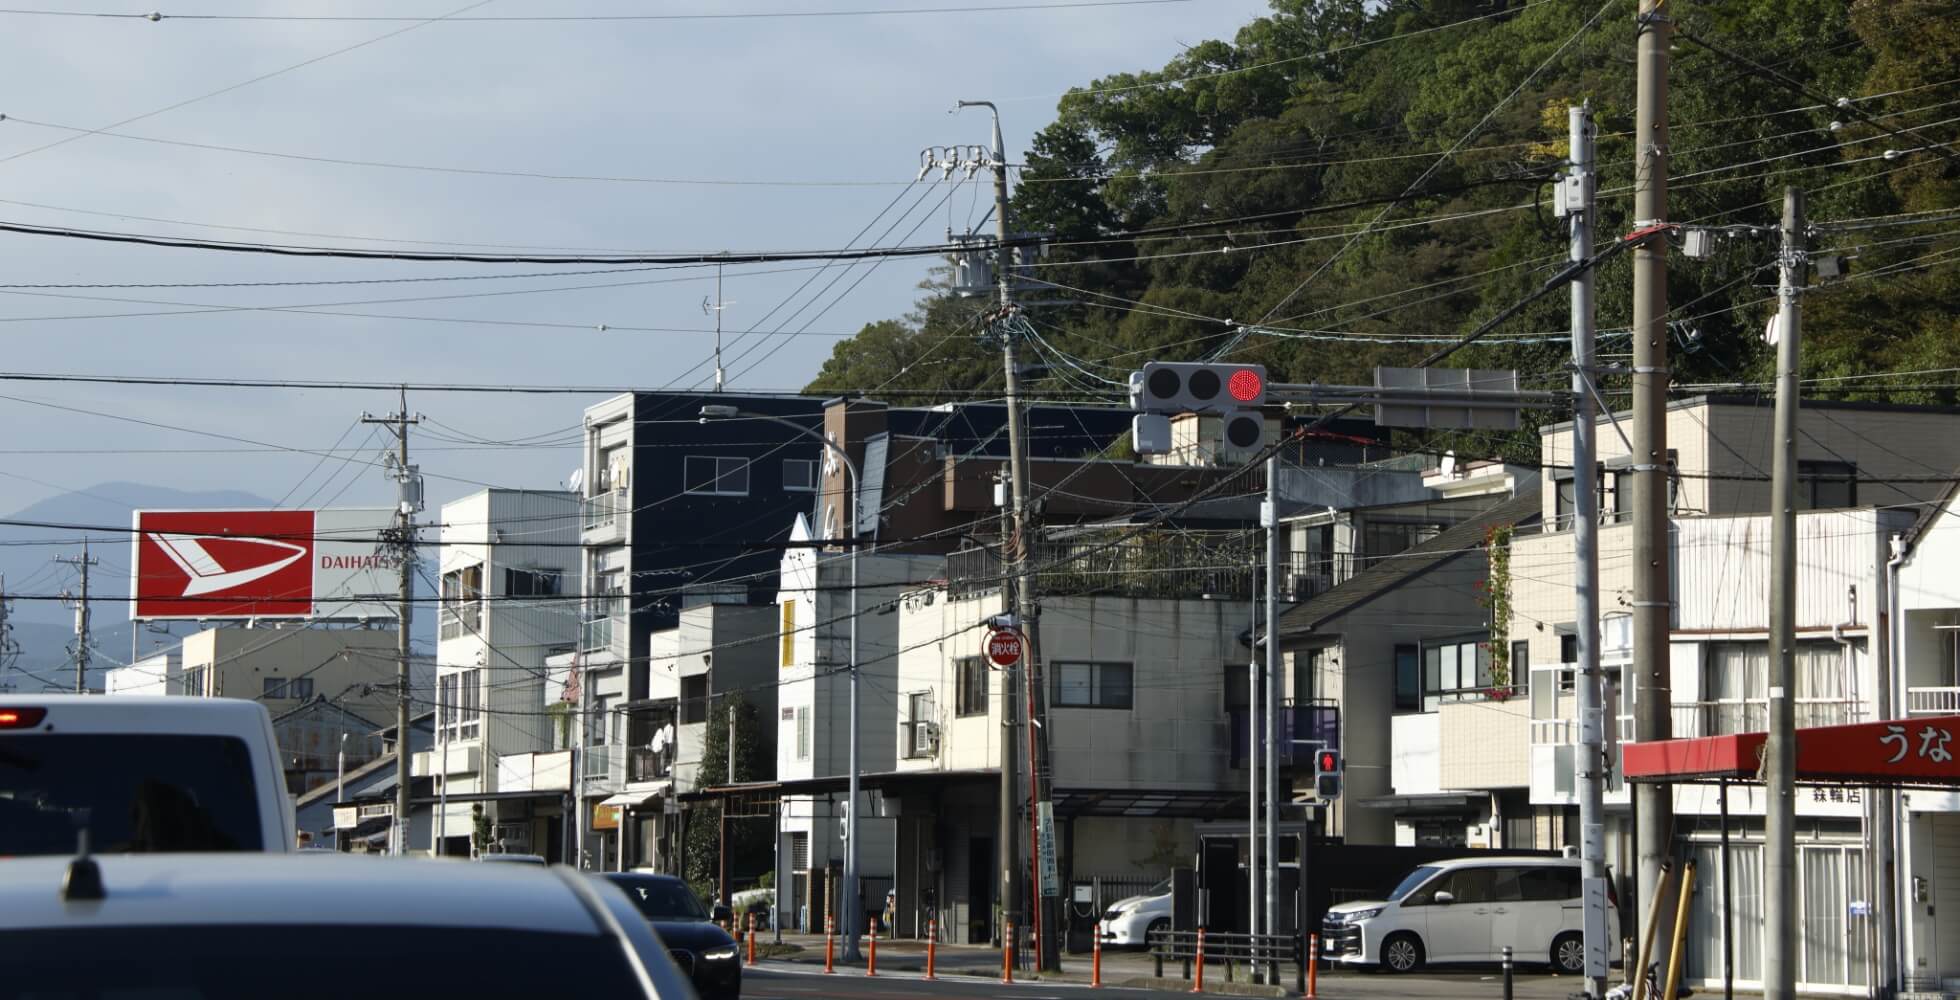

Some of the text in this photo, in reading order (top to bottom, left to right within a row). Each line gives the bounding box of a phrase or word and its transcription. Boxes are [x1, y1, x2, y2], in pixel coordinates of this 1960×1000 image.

[991, 641, 1020, 655] 消火栓
[1880, 725, 1952, 763] うな
